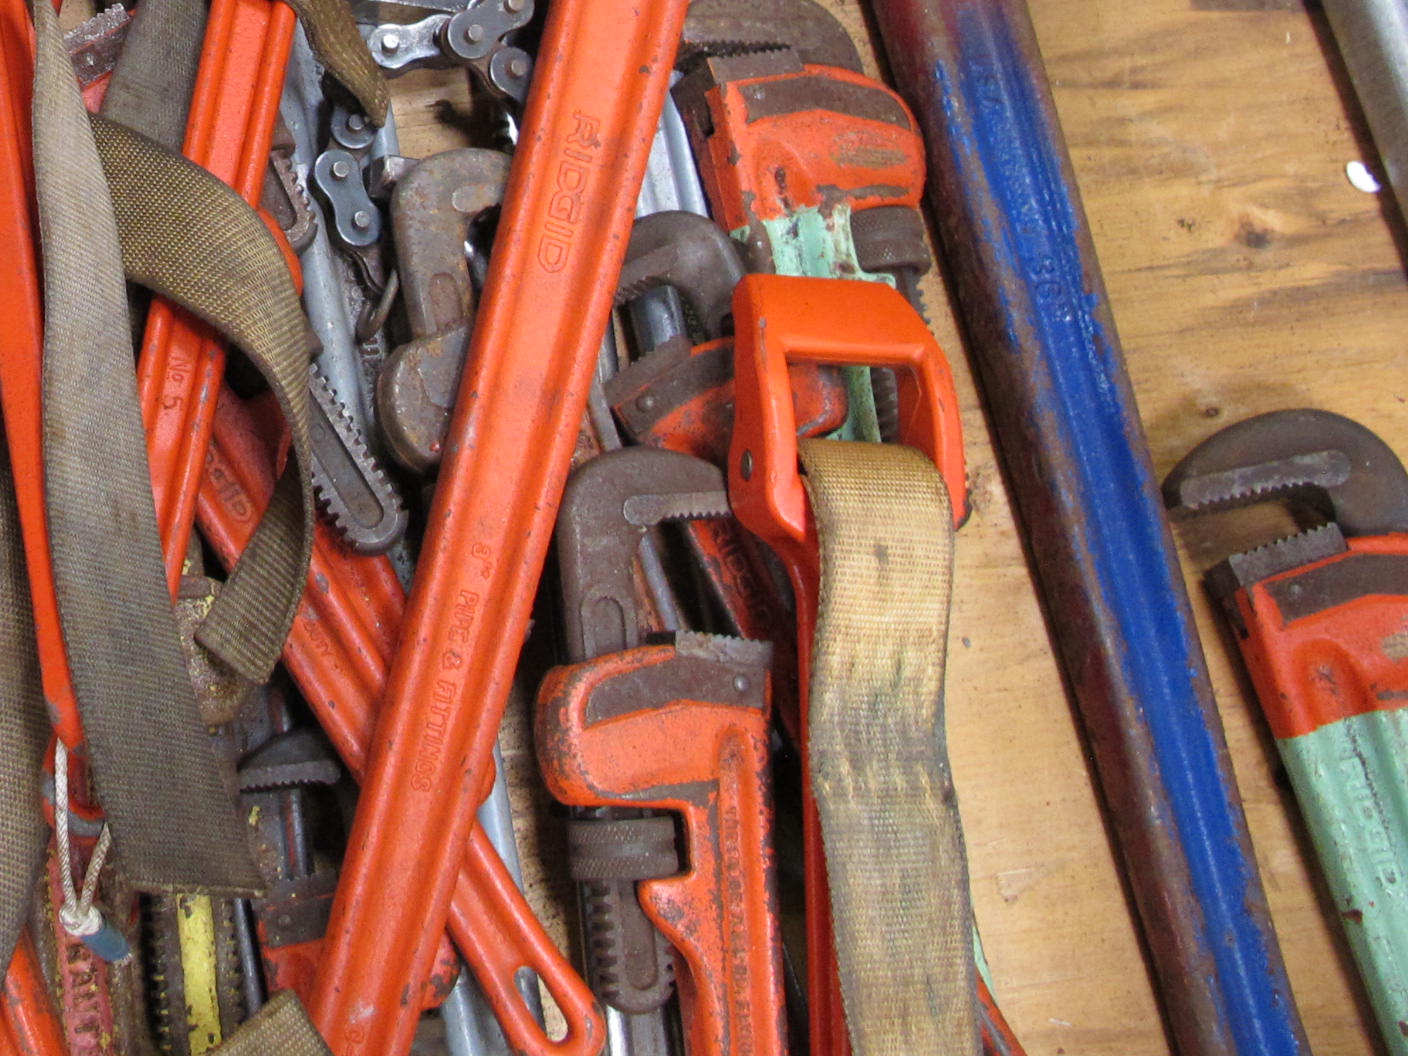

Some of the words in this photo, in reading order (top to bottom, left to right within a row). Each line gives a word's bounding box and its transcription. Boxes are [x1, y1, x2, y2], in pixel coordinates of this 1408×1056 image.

[536, 113, 600, 275] RIDGID
[439, 646, 465, 672] &
[447, 587, 480, 645] PIPE
[413, 679, 458, 793] FITTINGS
